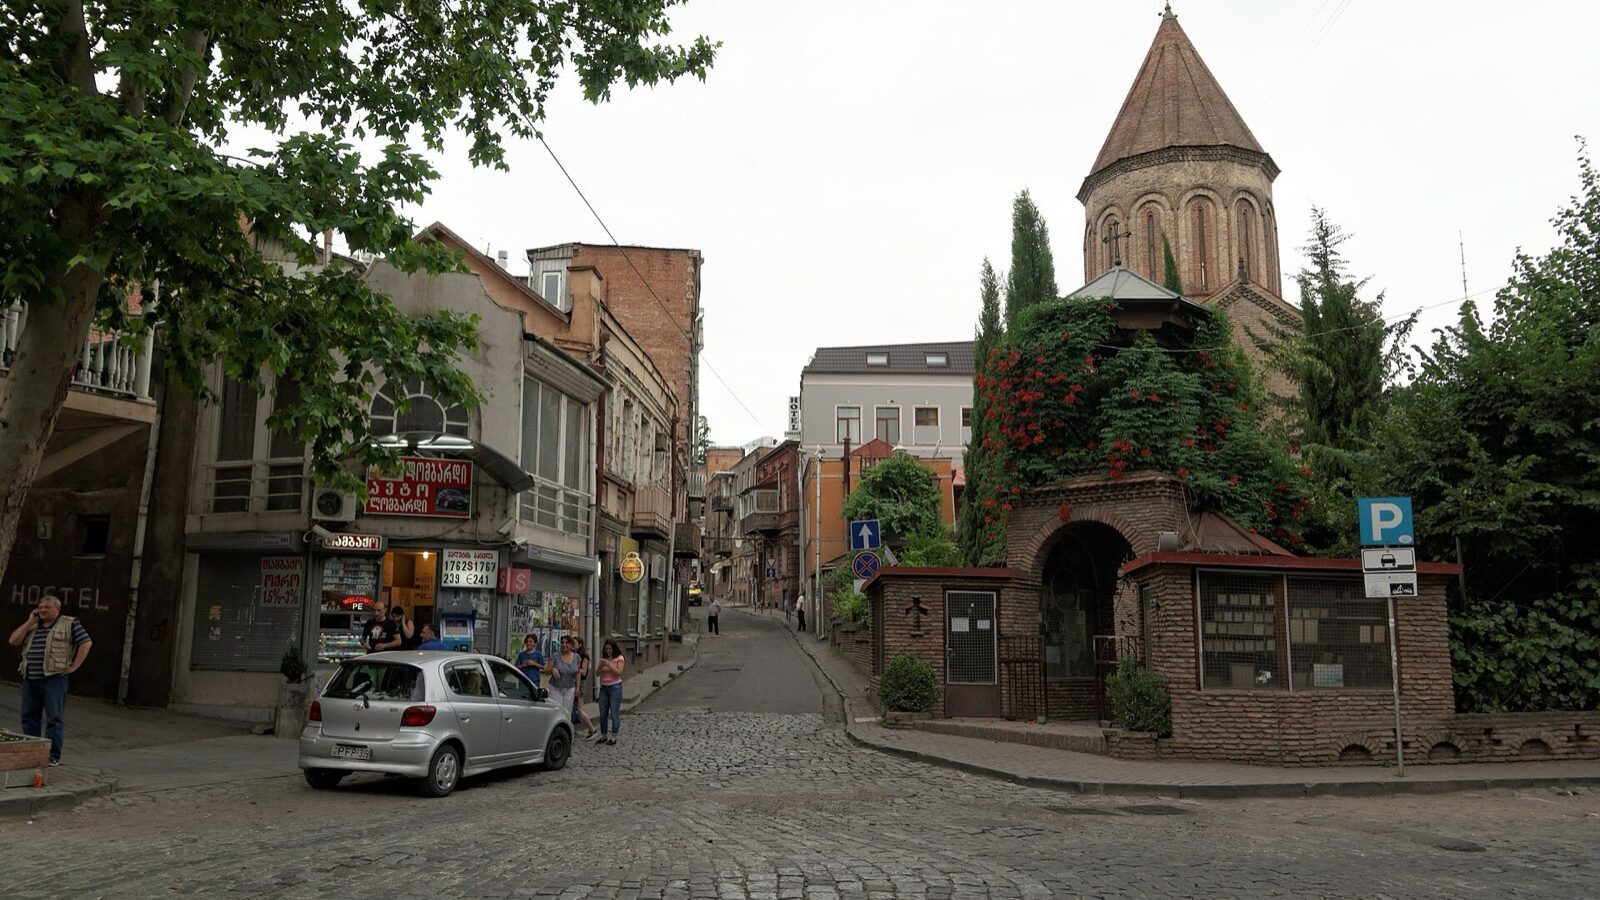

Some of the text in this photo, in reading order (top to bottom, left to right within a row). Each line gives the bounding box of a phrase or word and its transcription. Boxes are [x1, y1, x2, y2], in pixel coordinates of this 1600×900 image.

[790, 397, 798, 430] HOTEL
[370, 481, 429, 497] ავტო
[370, 497, 428, 512] ლომბარდი
[1371, 503, 1403, 541] P
[264, 574, 300, 588] ოქრო
[443, 573, 460, 584] 239
